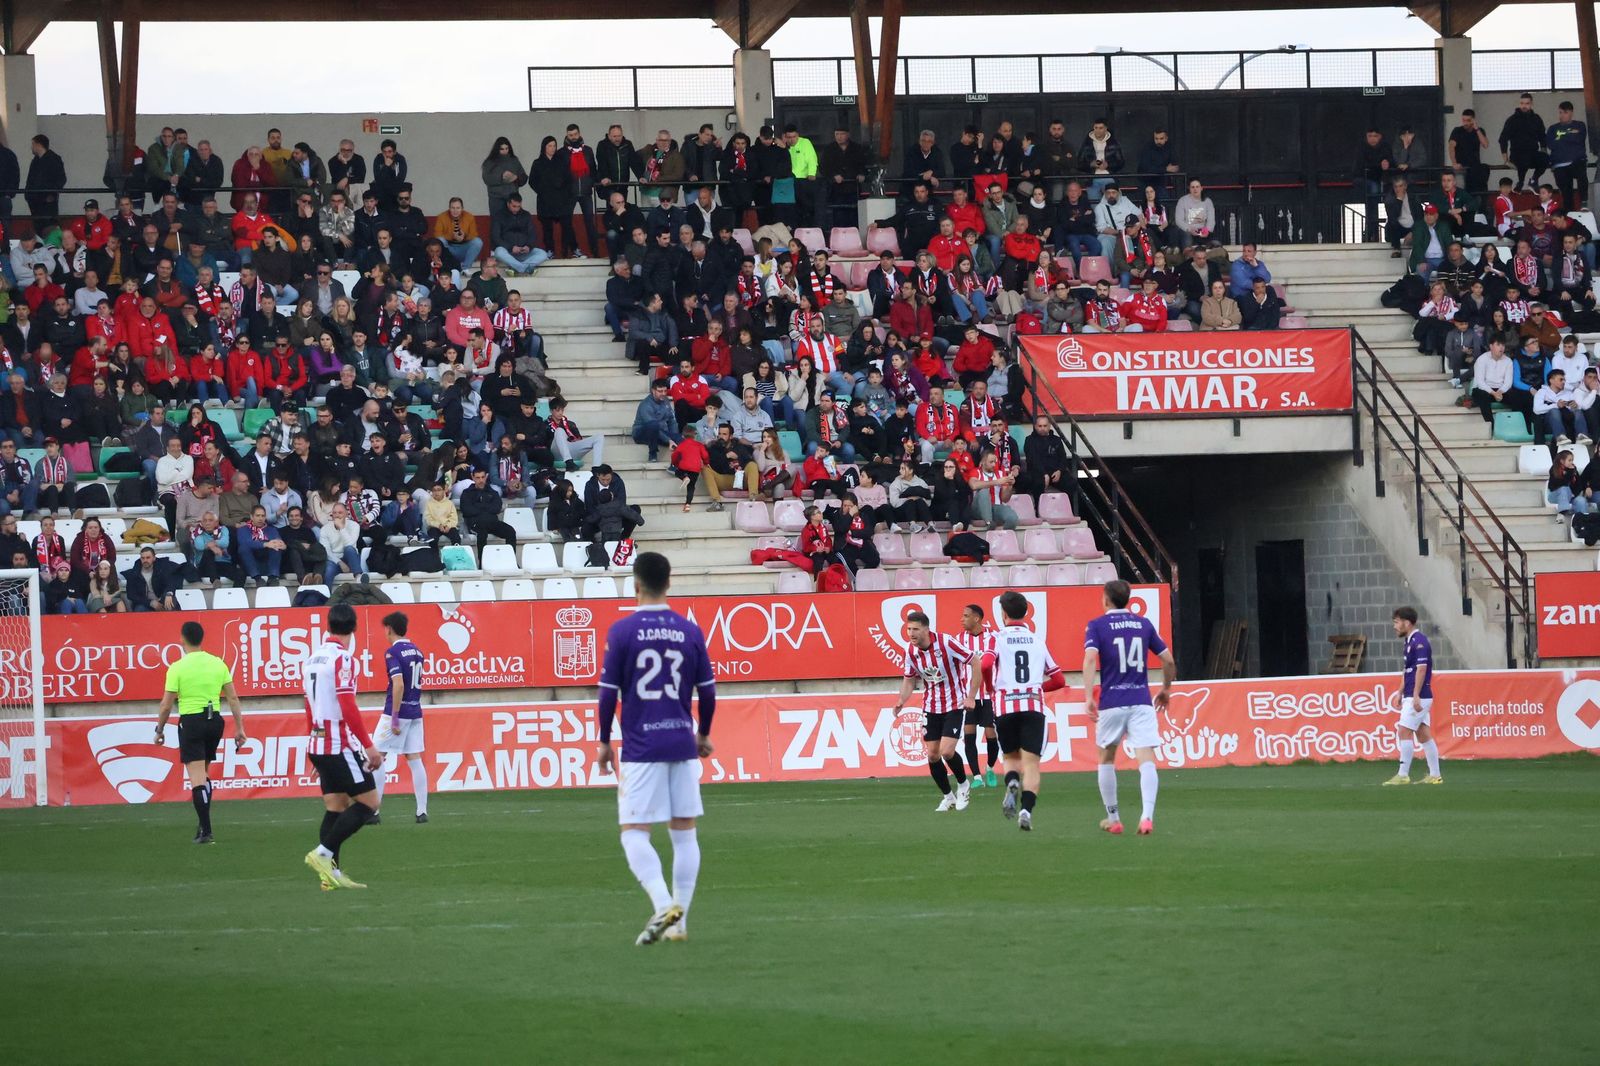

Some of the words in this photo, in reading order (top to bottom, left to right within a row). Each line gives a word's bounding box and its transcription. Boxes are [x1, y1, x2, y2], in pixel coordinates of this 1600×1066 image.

[1115, 374, 1268, 411] TAMAR,
[1280, 391, 1316, 407] S.A.
[618, 601, 833, 652] MORA
[637, 627, 685, 643] J.CASADO
[1109, 620, 1143, 630] TAVARES
[250, 613, 356, 682] fisi
[401, 648, 416, 657] DAVID
[868, 624, 905, 669] ZAMOR
[1007, 636, 1034, 645] MARCELO
[55, 638, 185, 672] ÓPTICO
[422, 651, 525, 676] doactiva
[1014, 650, 1030, 684] 8
[1113, 637, 1144, 673] 14
[310, 673, 317, 701] 7
[409, 661, 423, 690] 10
[459, 677, 464, 685] Y
[466, 673, 525, 685] BIOMECÁNICA
[636, 648, 684, 701] 23
[1451, 700, 1504, 716] Escucha
[1507, 699, 1544, 715] todos
[1253, 724, 1424, 759] infant
[1452, 723, 1471, 738] los
[1473, 722, 1527, 741] partidos
[1530, 724, 1546, 736] en
[711, 757, 760, 781] S.L.
[183, 777, 289, 790] RRIGERACION
